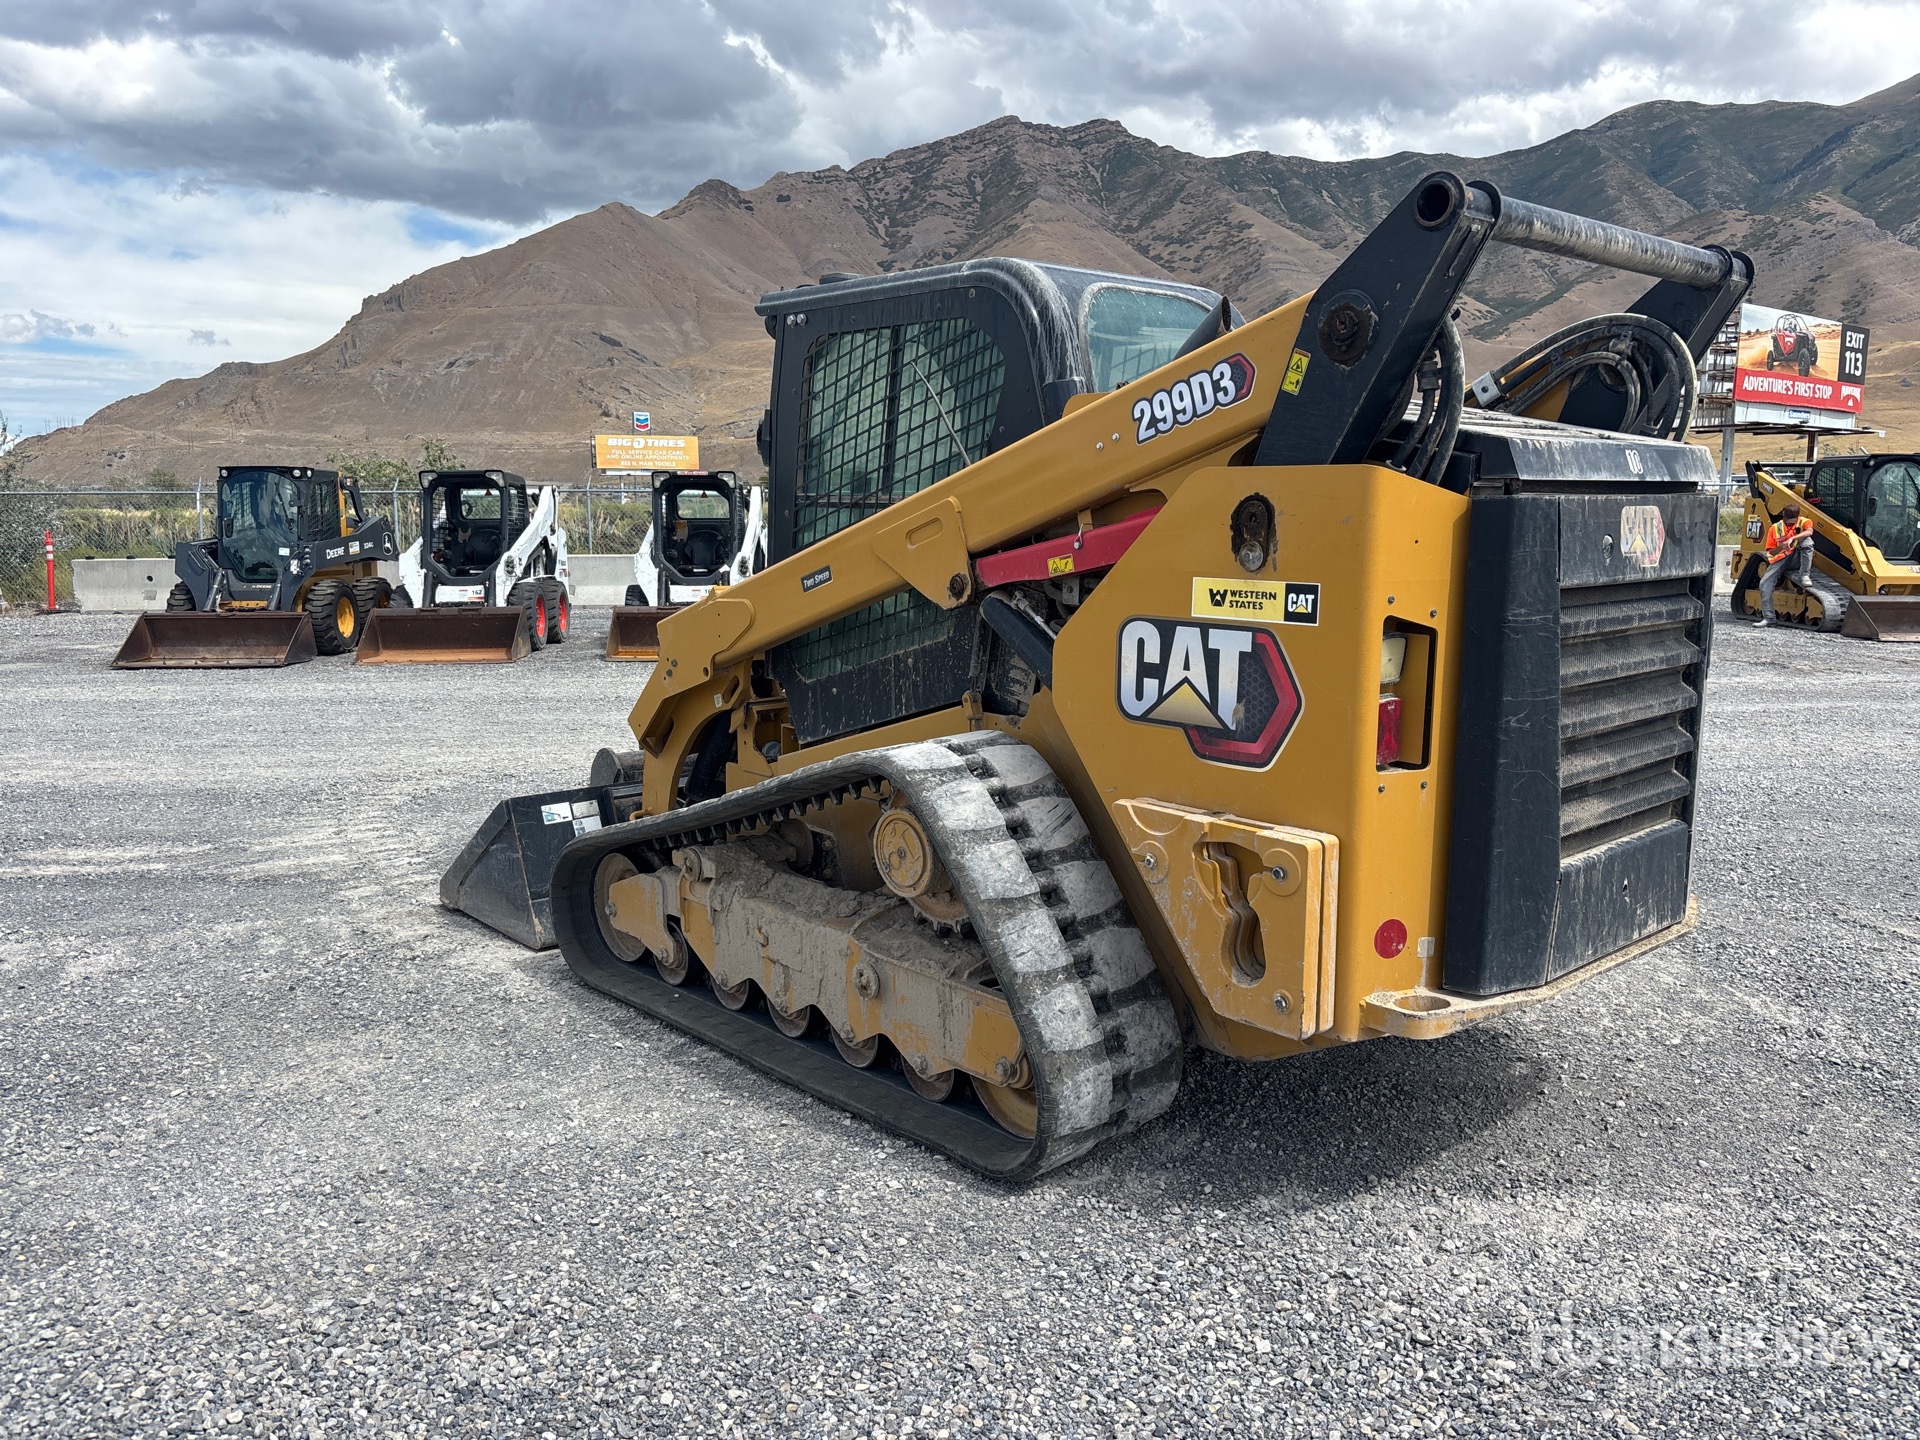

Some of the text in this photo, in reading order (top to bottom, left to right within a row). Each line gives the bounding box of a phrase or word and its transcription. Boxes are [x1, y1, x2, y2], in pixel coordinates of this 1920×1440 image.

[1846, 331, 1865, 349] EXIT
[1845, 351, 1863, 376] 113
[1743, 375, 1833, 399] ADVENTURE'S FIRST STOP
[1133, 362, 1236, 442] 299D3
[608, 438, 632, 446] BIG
[646, 439, 686, 448] TIRES
[1747, 522, 1762, 538] CAT
[326, 546, 345, 559] DEERE
[1230, 589, 1277, 600] WESTERN
[1287, 593, 1314, 613] CAT
[1229, 600, 1263, 610] STATES
[1120, 620, 1253, 731] CAT
